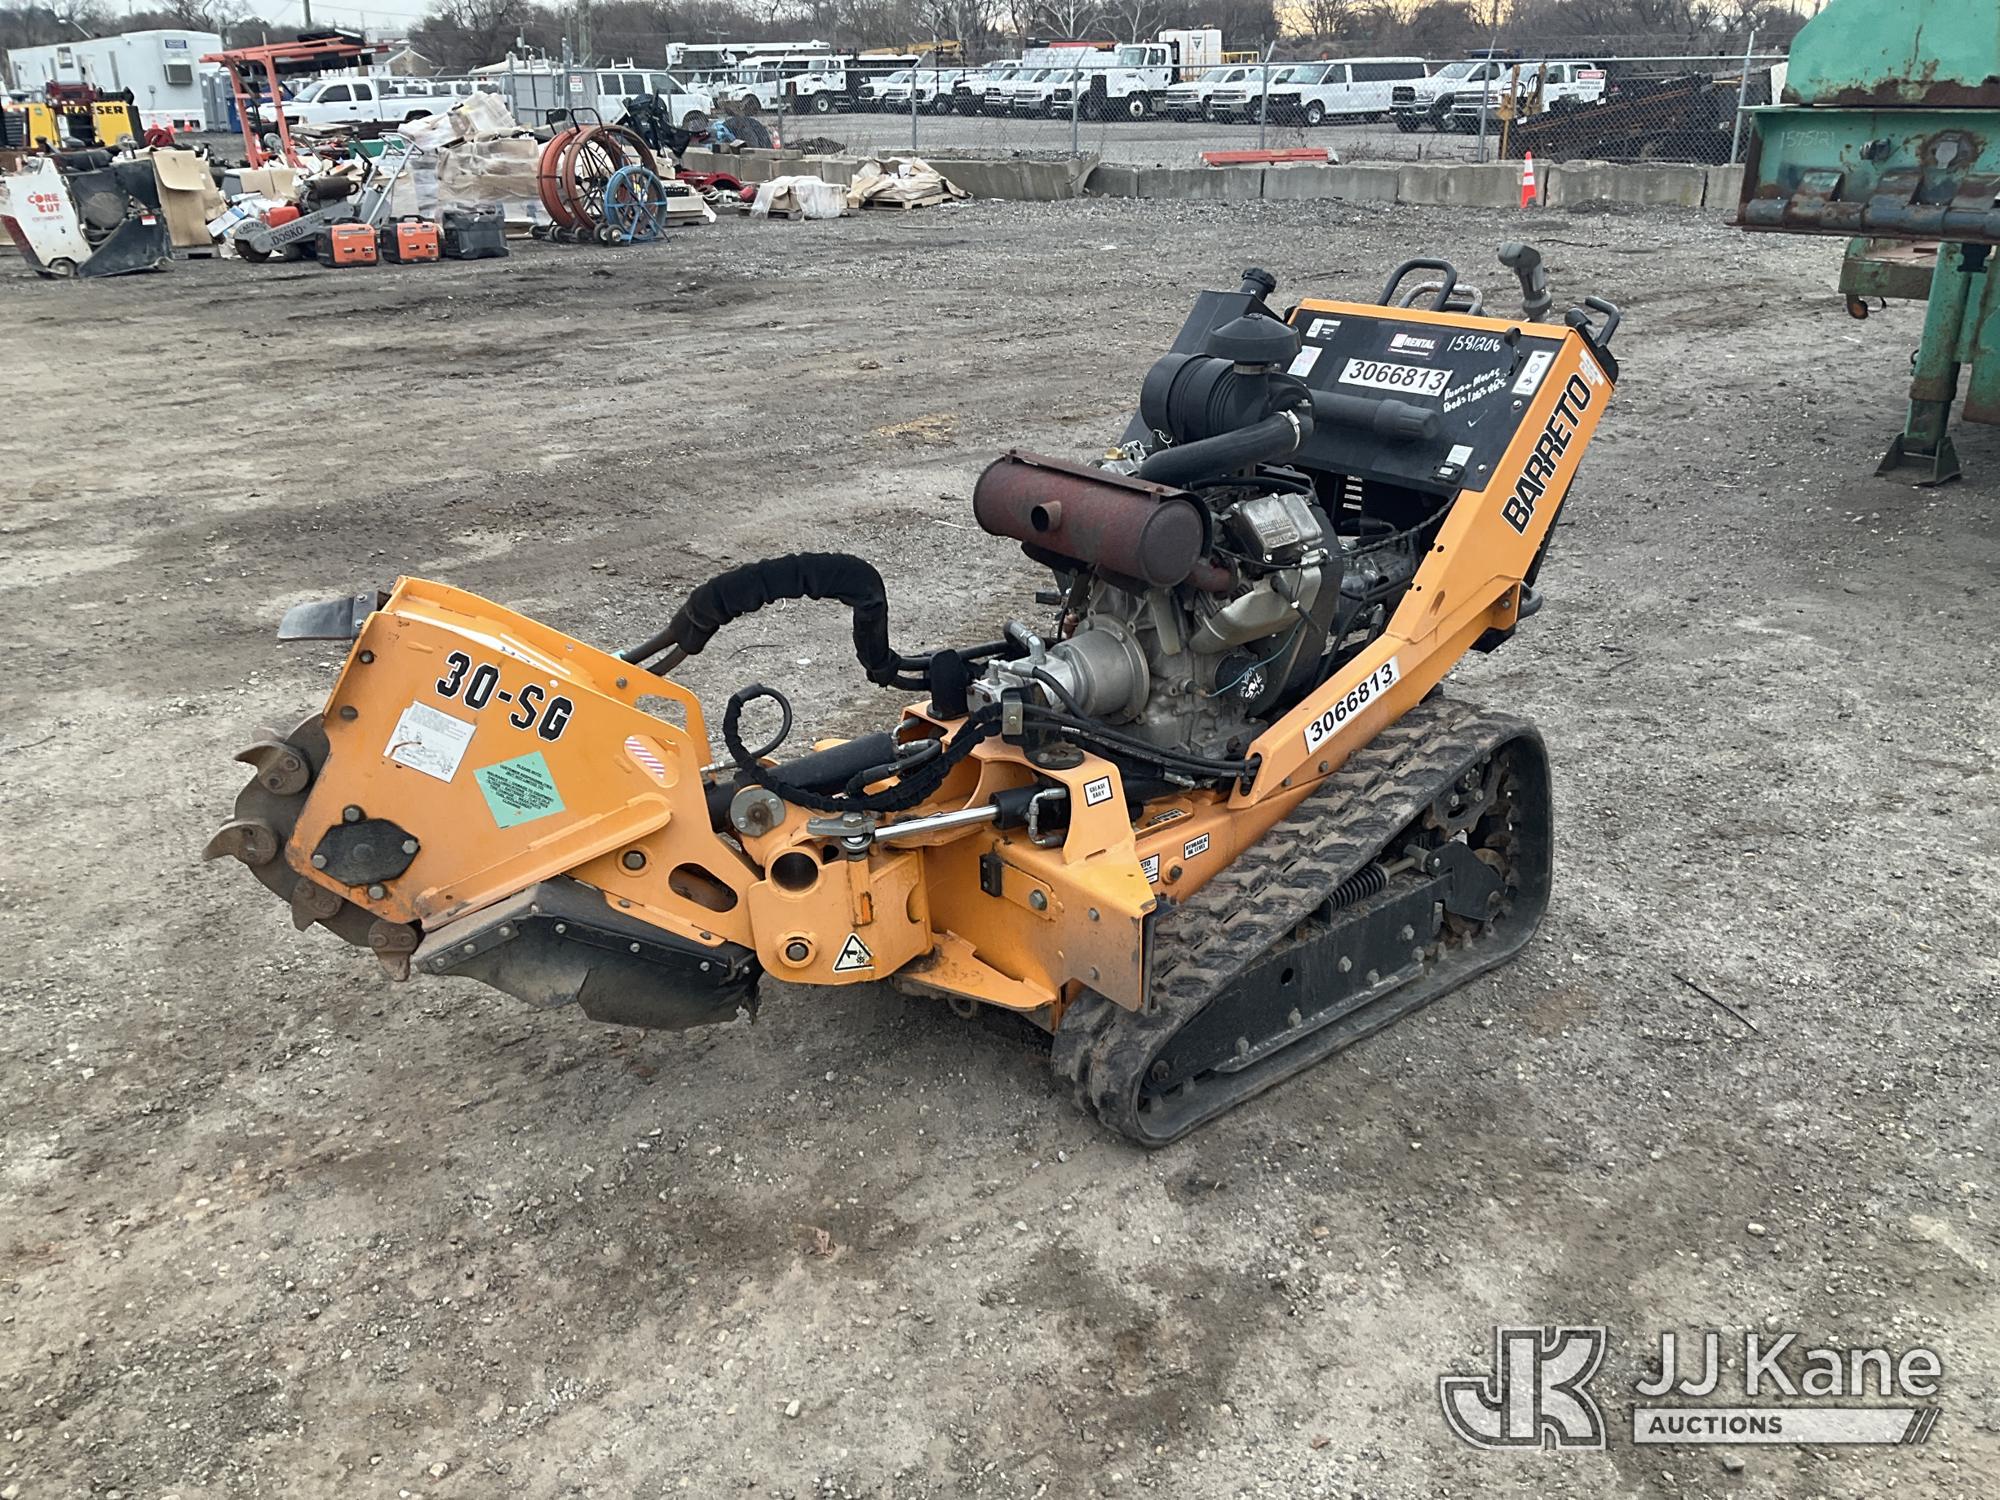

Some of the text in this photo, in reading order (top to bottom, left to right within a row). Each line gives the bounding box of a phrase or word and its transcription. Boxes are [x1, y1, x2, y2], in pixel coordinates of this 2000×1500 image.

[27, 192, 60, 204] CORE
[36, 203, 60, 213] CUT
[271, 226, 304, 246] DOSKO
[1403, 337, 1436, 349] RENTAL
[1446, 335, 1501, 352] 1581206
[1349, 361, 1446, 390] 3066813
[1500, 372, 1591, 536] BARRETO
[435, 650, 575, 743] 30-SG
[1310, 663, 1393, 742] 3066813
